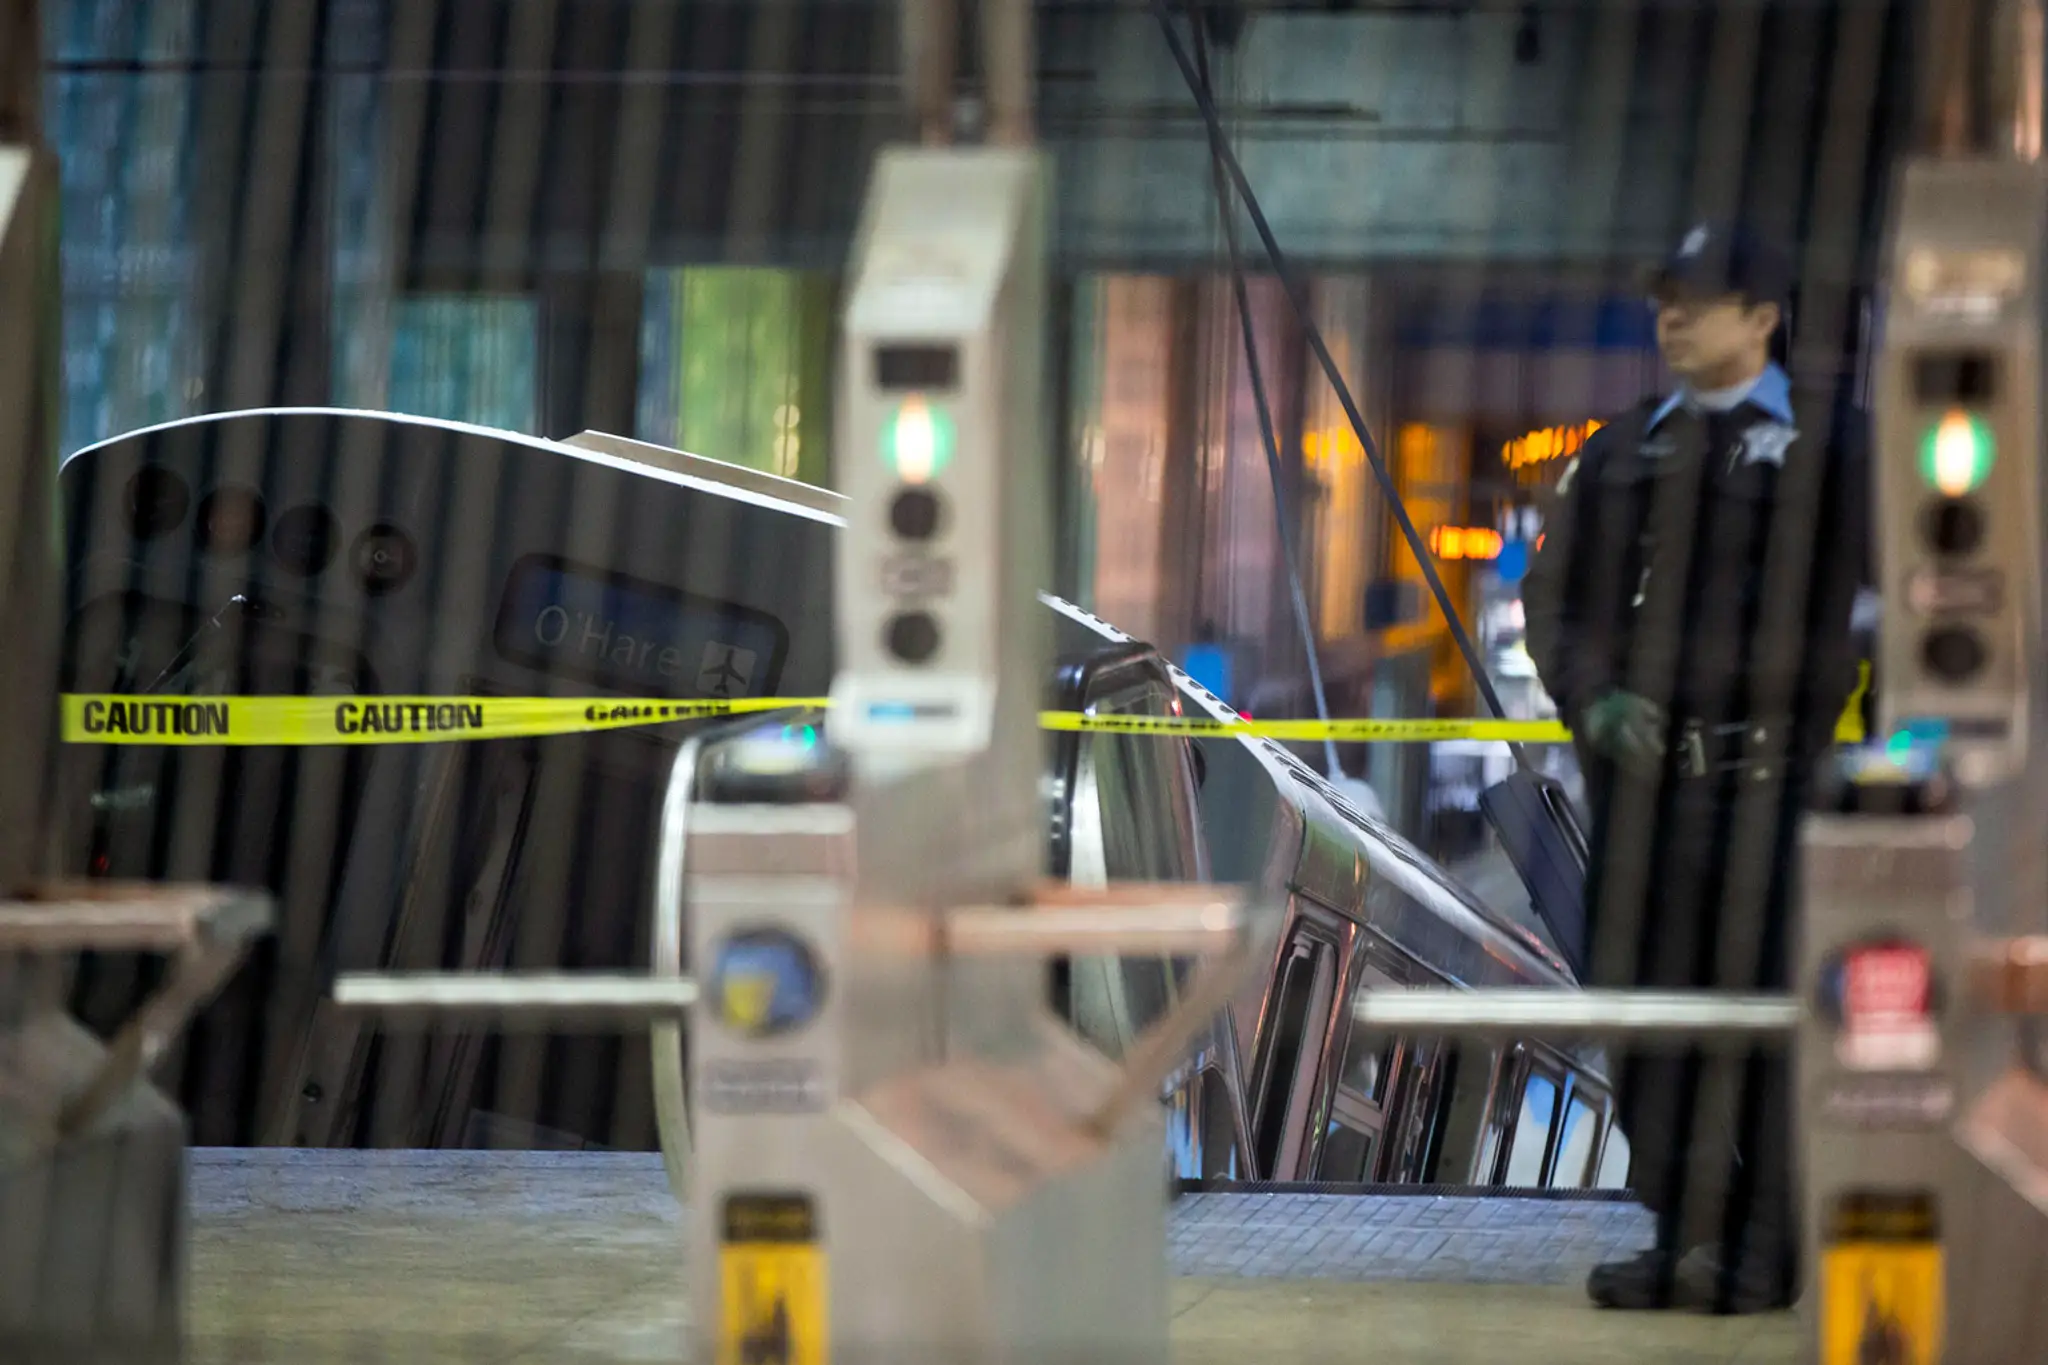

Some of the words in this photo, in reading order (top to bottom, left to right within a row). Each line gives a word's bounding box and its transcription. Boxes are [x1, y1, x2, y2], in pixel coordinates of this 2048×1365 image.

[535, 605, 680, 676] O'Hare
[83, 701, 229, 735] CAUTION
[335, 702, 482, 734] CAUTION
